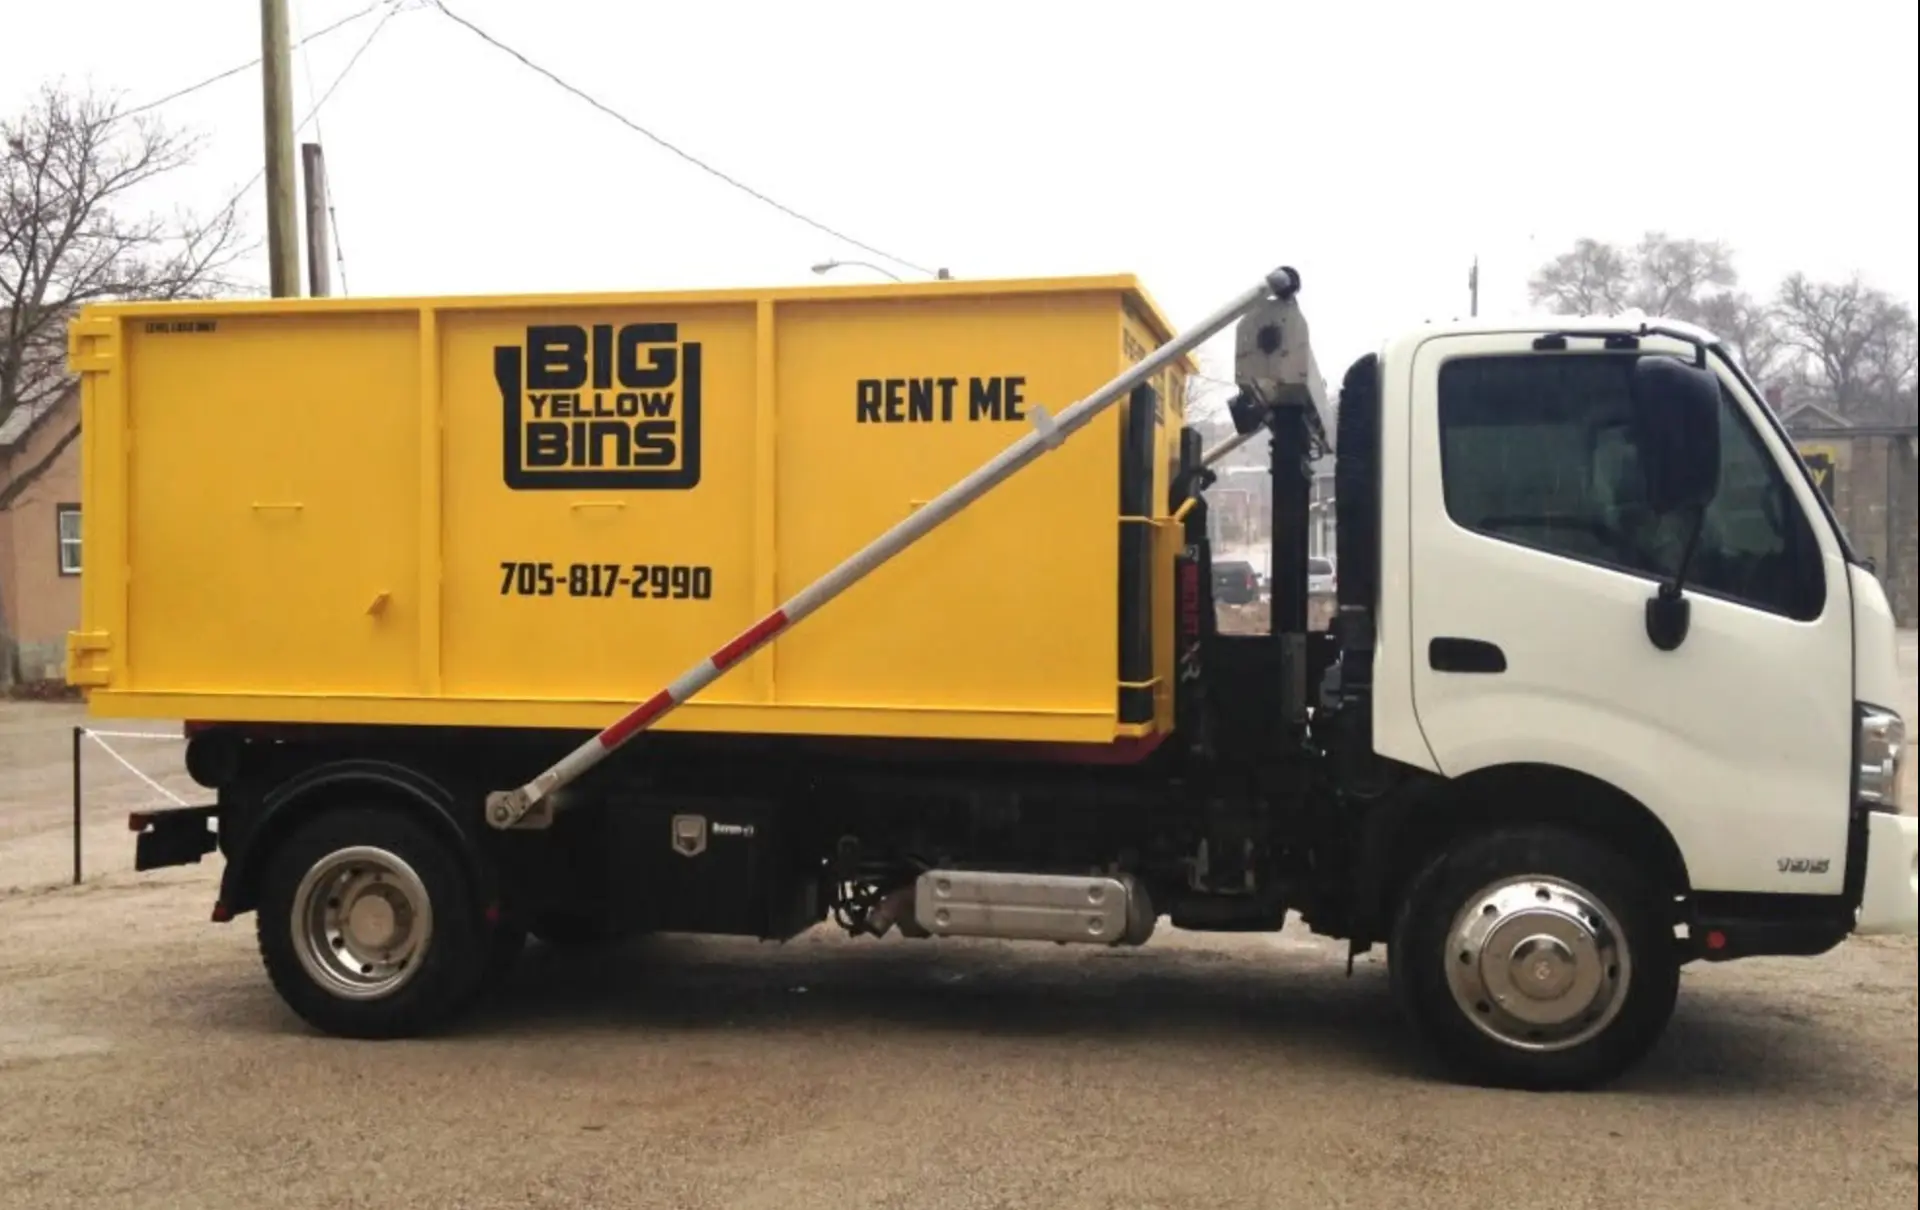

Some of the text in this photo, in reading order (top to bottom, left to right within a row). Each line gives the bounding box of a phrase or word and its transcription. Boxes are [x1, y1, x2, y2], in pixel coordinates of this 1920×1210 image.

[526, 322, 678, 390] BIG
[527, 392, 674, 418] YELLOW
[856, 376, 1026, 423] RENT ME
[526, 420, 676, 467] BINS
[500, 562, 712, 600] 705-817-2990
